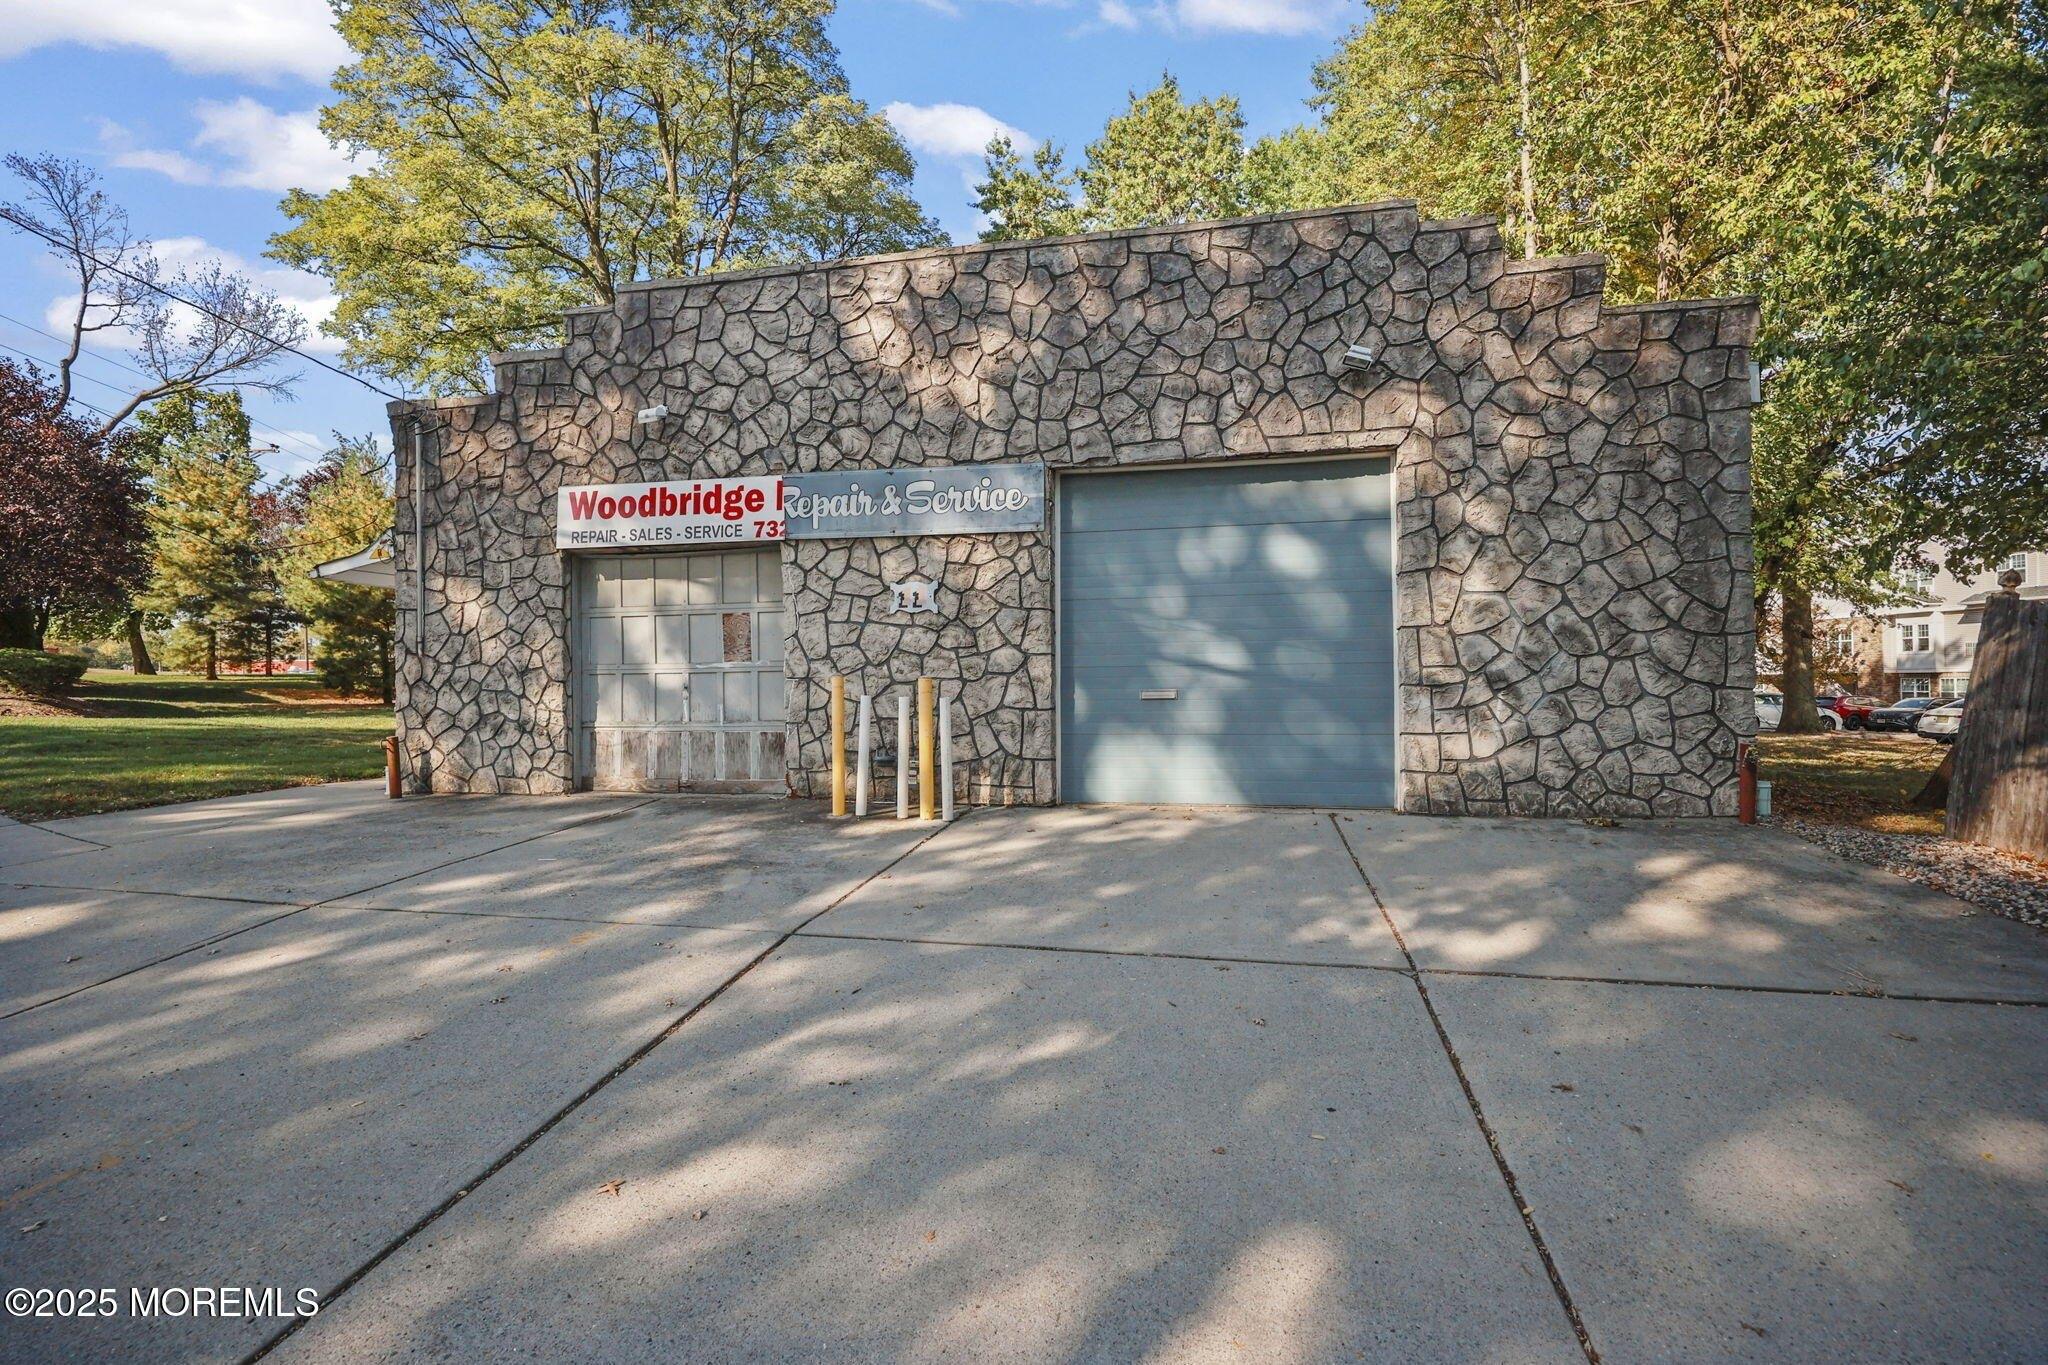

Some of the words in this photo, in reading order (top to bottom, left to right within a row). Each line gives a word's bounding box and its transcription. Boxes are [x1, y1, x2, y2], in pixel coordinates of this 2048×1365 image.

[569, 483, 765, 521] Woodbridge
[783, 481, 878, 530] Repair
[880, 484, 902, 516] &
[905, 477, 1029, 515] Service
[571, 529, 618, 544] REPAIR
[629, 527, 673, 542] SALES
[684, 524, 743, 540] SERVICE
[898, 591, 922, 608] 11
